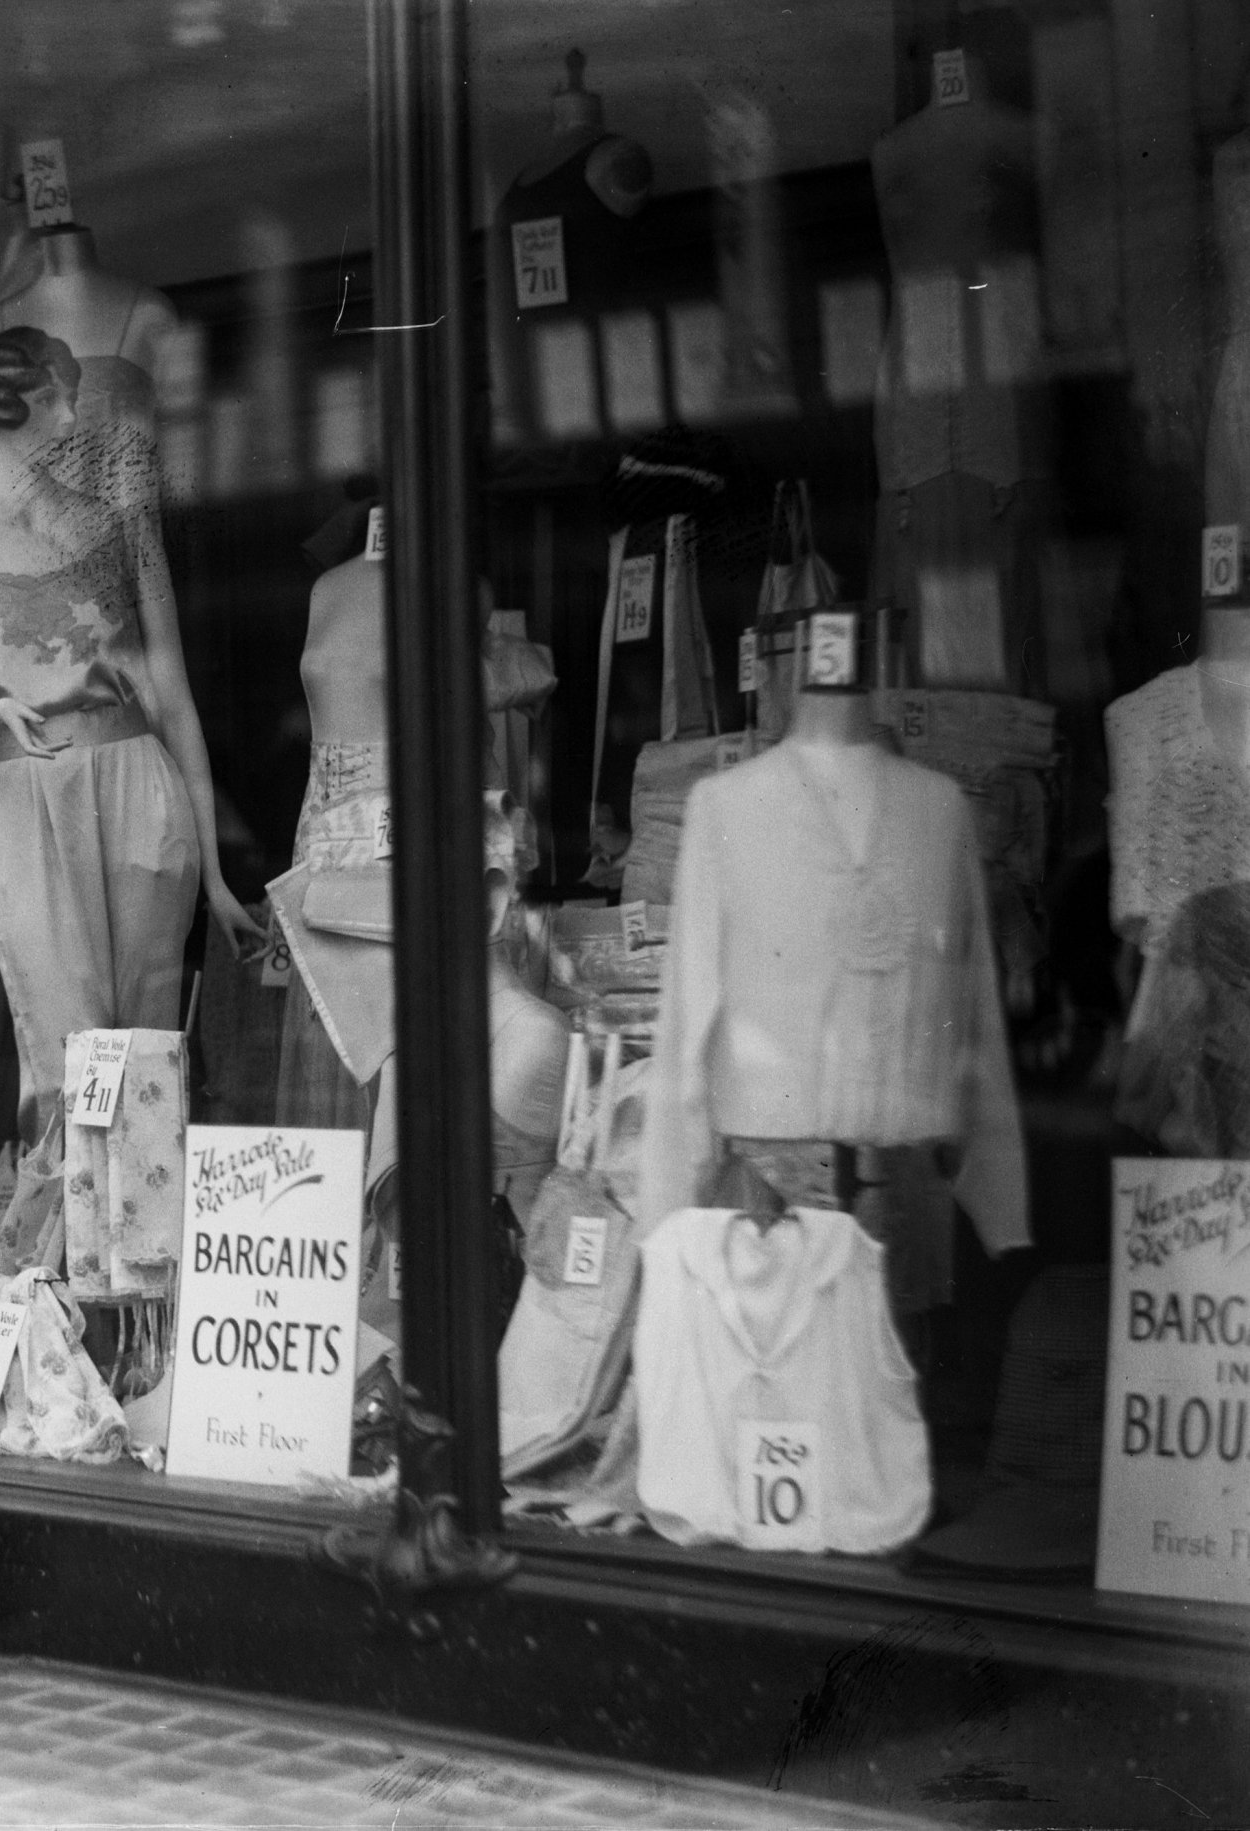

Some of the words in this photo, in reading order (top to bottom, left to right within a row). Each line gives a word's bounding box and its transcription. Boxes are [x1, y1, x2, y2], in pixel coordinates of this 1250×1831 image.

[89, 1049, 122, 1063] Chemise
[227, 1171, 267, 1203] Day
[273, 1140, 315, 1184] Sale
[194, 1232, 349, 1281] BARGAINS
[255, 1289, 279, 1308] IN
[1129, 1289, 1250, 1347] BARG
[192, 1315, 342, 1375] CORSETS
[1216, 1360, 1249, 1385] IN
[206, 1416, 249, 1448] First
[259, 1421, 309, 1452] Floor
[1122, 1393, 1250, 1462] BLOU
[753, 1473, 804, 1526] 10
[1152, 1519, 1217, 1558] First
